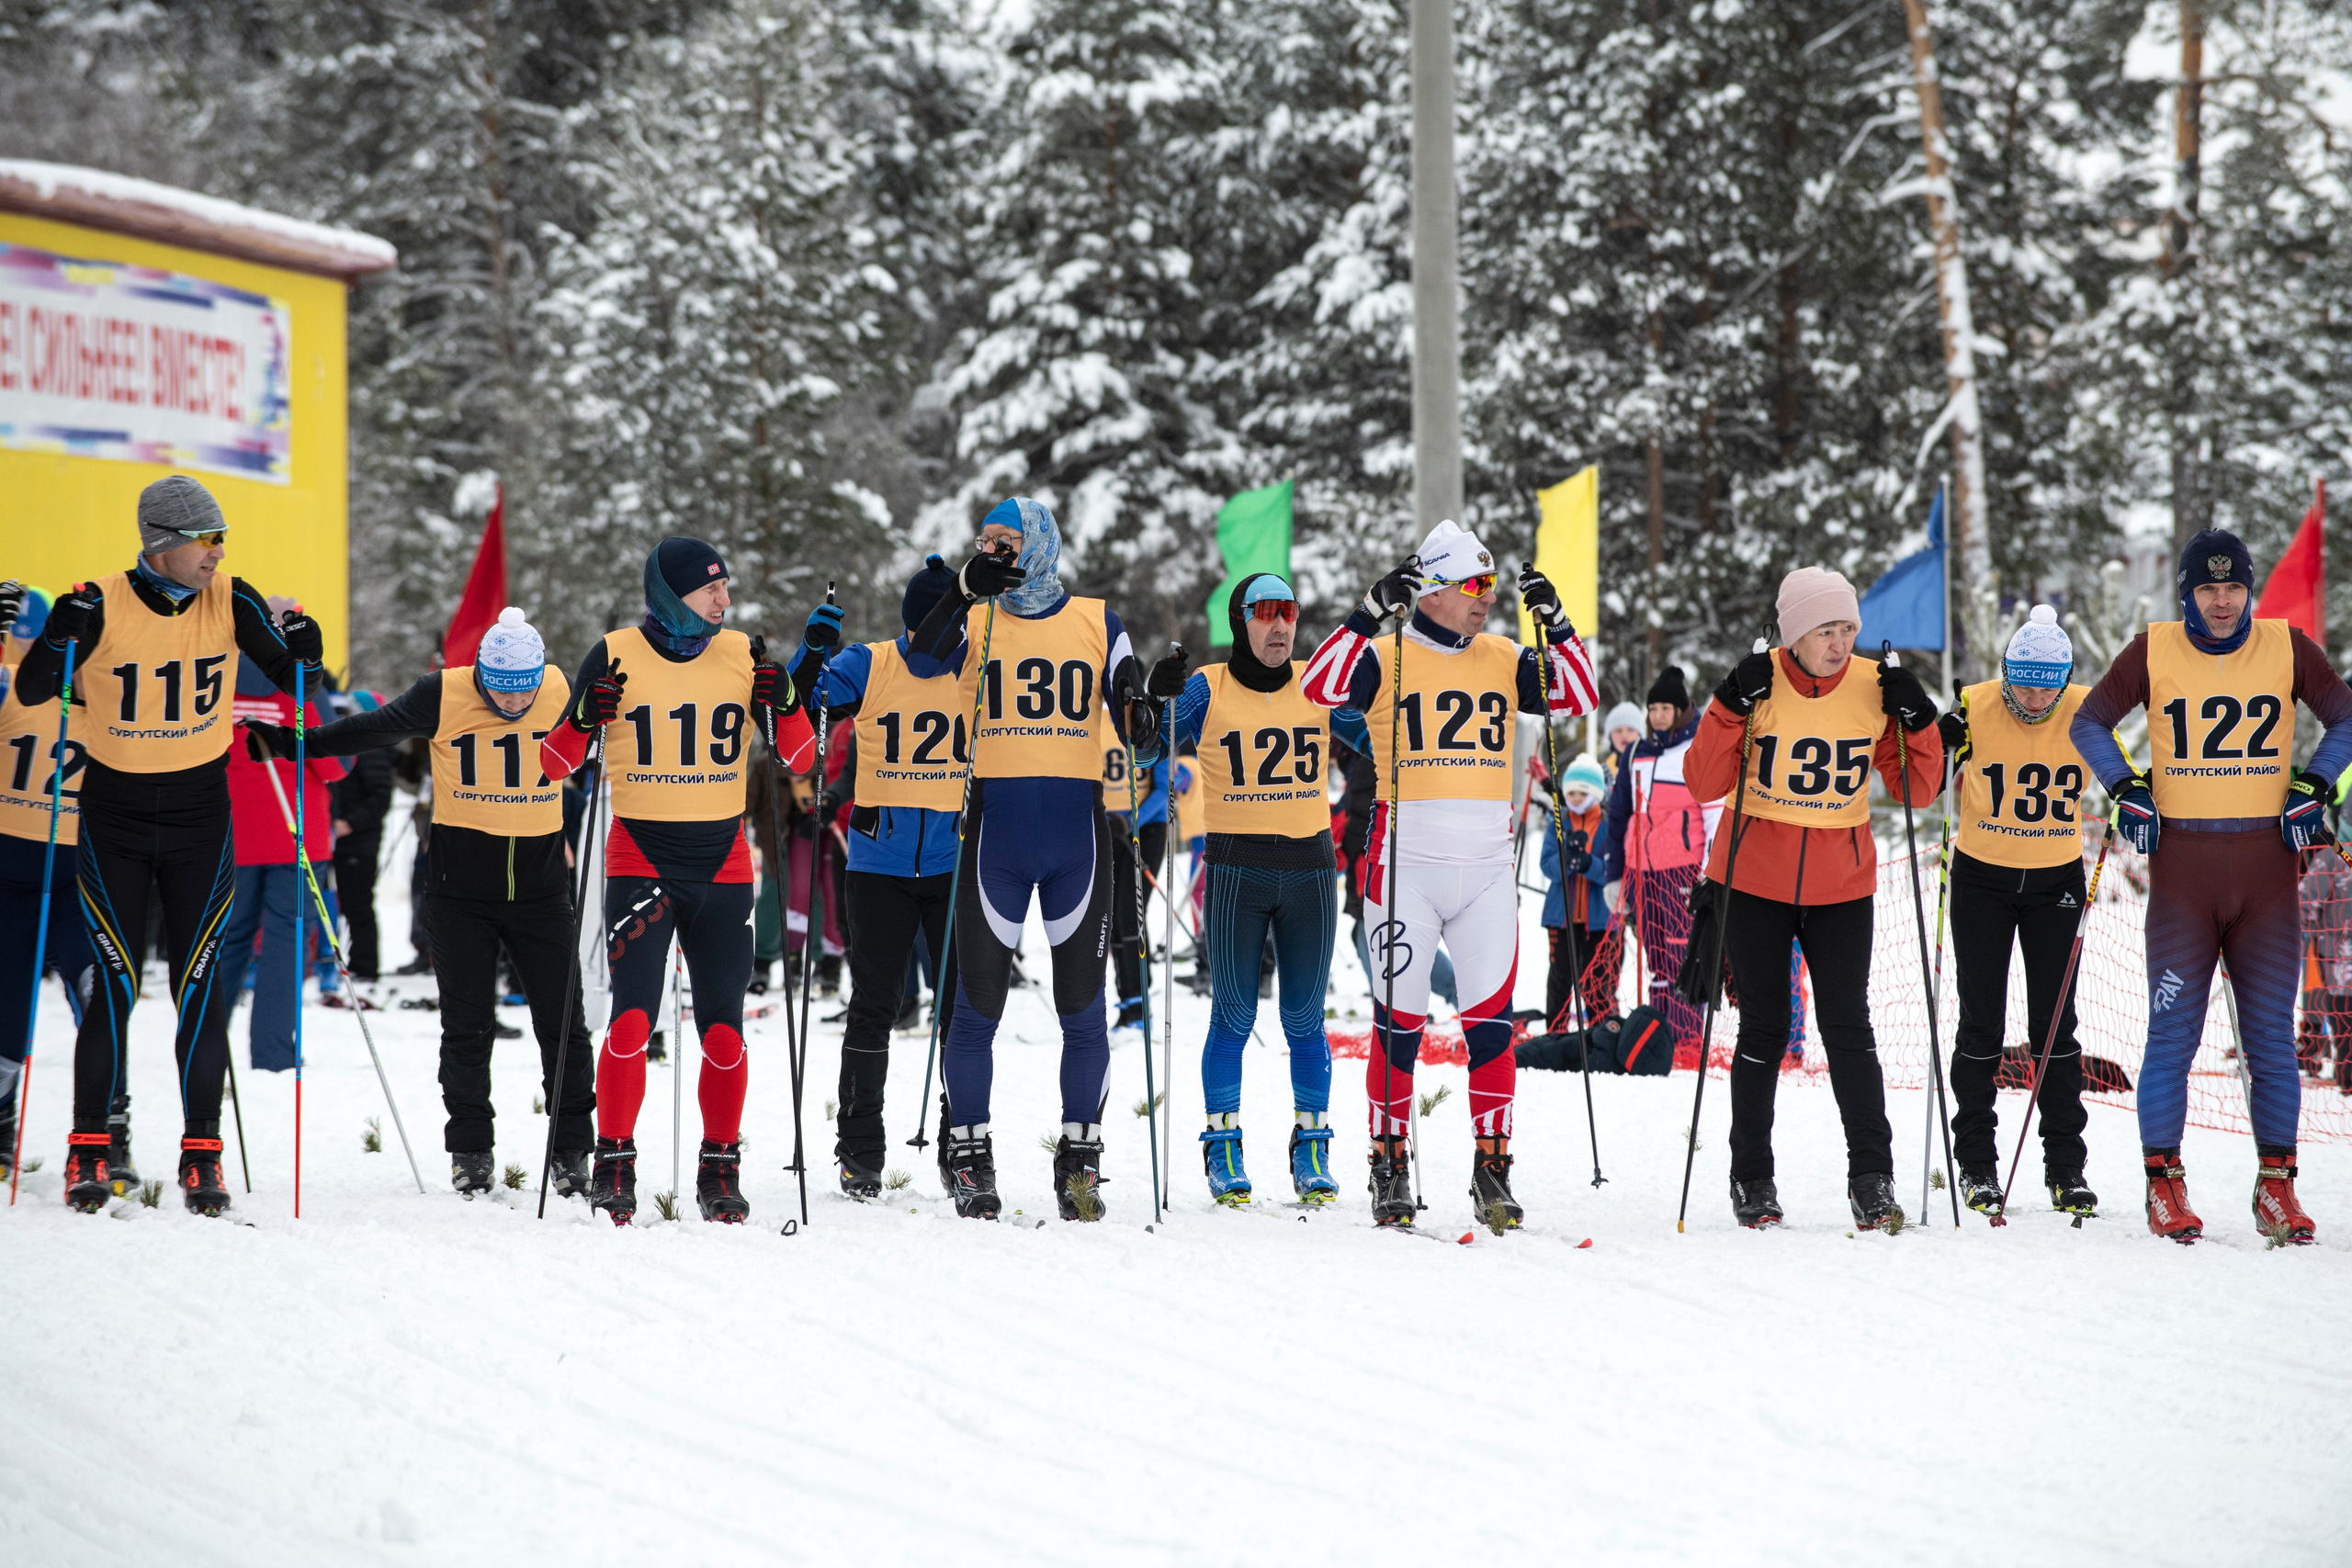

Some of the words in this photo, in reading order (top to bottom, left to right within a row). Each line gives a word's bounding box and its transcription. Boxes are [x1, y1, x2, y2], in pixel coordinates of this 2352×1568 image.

[26, 306, 144, 405] СИЛЬНЕЕ!
[151, 325, 245, 422] ВМЕСТЕ!
[1423, 552, 1451, 567] SCANIA
[111, 652, 228, 723] 115
[483, 672, 533, 686] РОССИИ
[978, 656, 1095, 723] 130
[2010, 669, 2059, 681] РОССИИ
[108, 726, 188, 739] СУРГУТСКИЙ
[191, 714, 219, 736] РАЙОН
[624, 702, 746, 768] 119
[765, 704, 775, 747] MADSHUS
[980, 725, 1053, 739] СУРГУТСКИЙ
[1057, 727, 1090, 739] РАЙОН
[1398, 689, 1509, 754] 123
[2162, 694, 2282, 761] 122
[597, 724, 607, 764] MADSHUS
[1218, 726, 1321, 787] 125
[1398, 756, 1476, 768] СУРГУТСКИЙ
[1479, 757, 1507, 769] РАЙОН
[7, 733, 88, 800] 12
[626, 772, 705, 784] СУРГУТСКИЙ
[708, 771, 739, 784] РАЙОН
[876, 769, 947, 781] СУРГУТСКИЙ
[949, 768, 968, 780] РАЙ
[962, 735, 978, 824] SWIX
[1753, 734, 1872, 797] 135
[2165, 764, 2243, 777] СУРГУТСКИЙ
[2245, 763, 2281, 776] РАЙОН
[453, 790, 528, 804] СУРГУТСКИЙ
[531, 791, 560, 804] РАЙОН
[1223, 790, 1293, 803] СУРГУТСКИЙ
[1295, 788, 1320, 800] РАЙОН
[1981, 761, 2083, 823] 133
[1977, 819, 2045, 838] СУРГУТСКИЙ
[2048, 827, 2075, 838] РАЙО
[1135, 867, 1145, 944] SWIX
[96, 932, 120, 962] CRAFT
[1097, 922, 1108, 958] CRAFT
[192, 946, 213, 979] CRAFT
[2258, 1185, 2288, 1224] lpina
